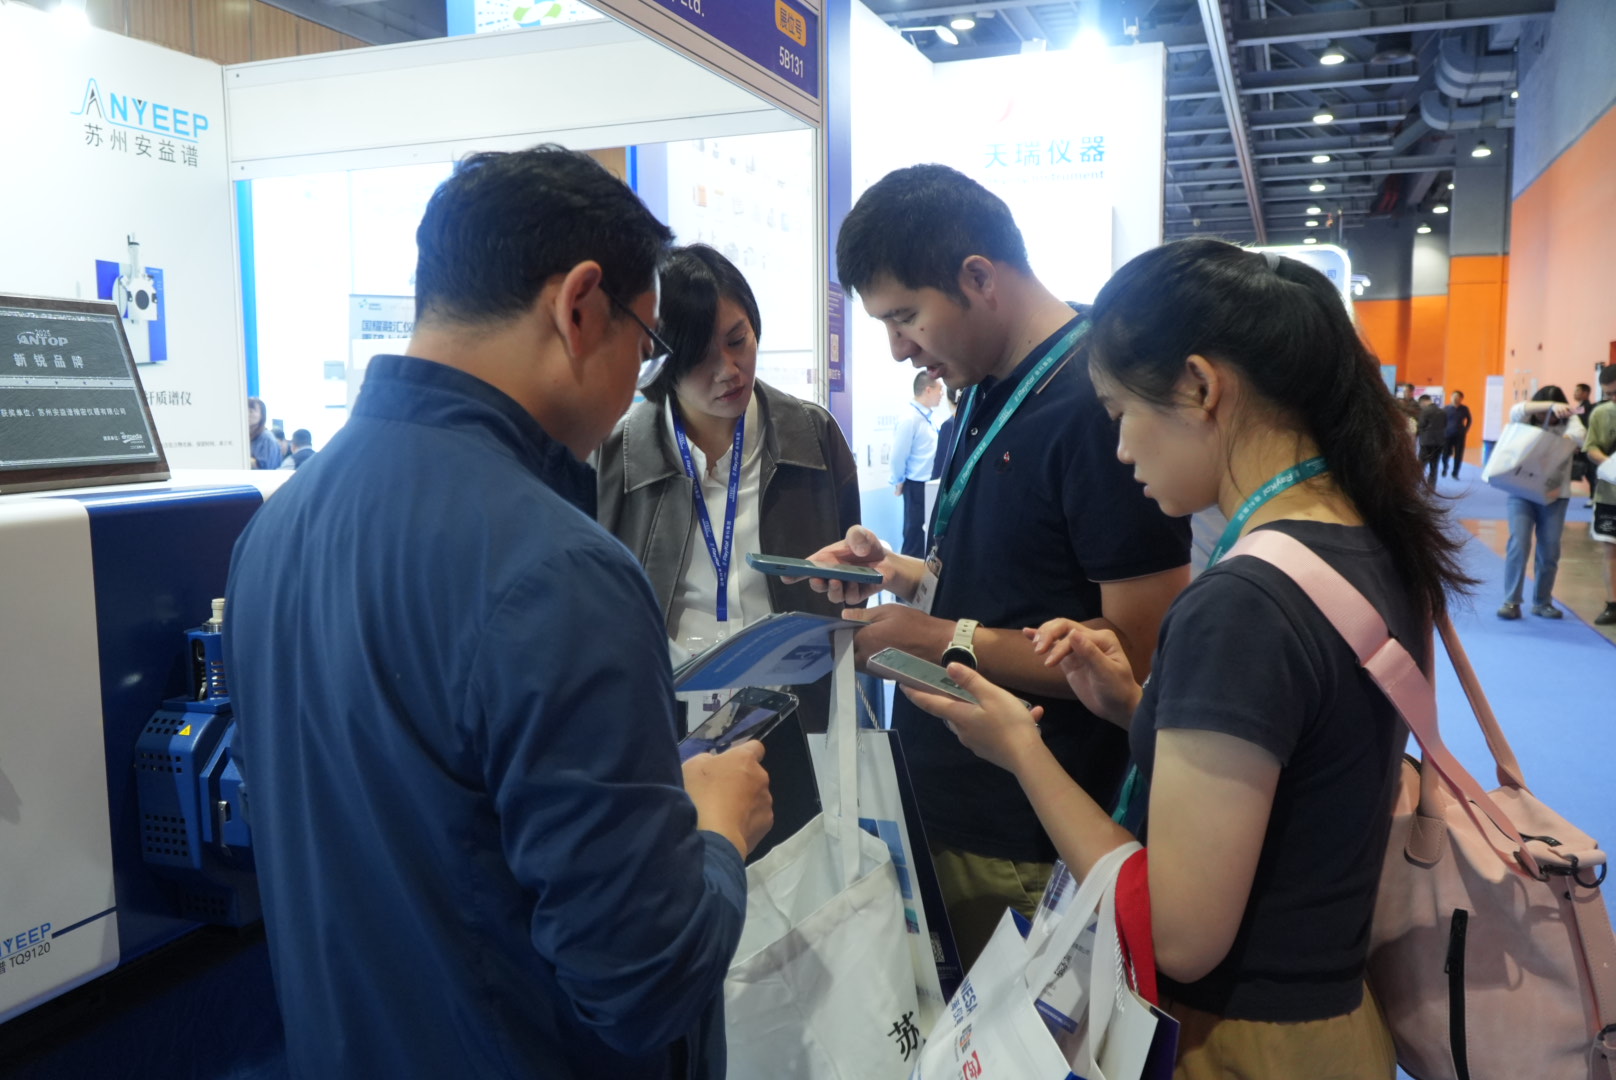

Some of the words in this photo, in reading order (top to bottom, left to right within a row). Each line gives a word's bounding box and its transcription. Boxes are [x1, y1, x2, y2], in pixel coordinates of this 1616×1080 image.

[779, 46, 804, 78] 5B131
[70, 78, 209, 138] ANYEEP
[84, 122, 199, 168] 苏州安益谱
[984, 135, 1105, 168] 天瑞仪器
[17, 331, 69, 346] ANTOP
[13, 353, 84, 369] 新锐品牌
[1263, 473, 1294, 496] RayKol
[0, 922, 52, 957] YEEP
[9, 942, 51, 968] TQ9120
[888, 1011, 927, 1063] 苏
